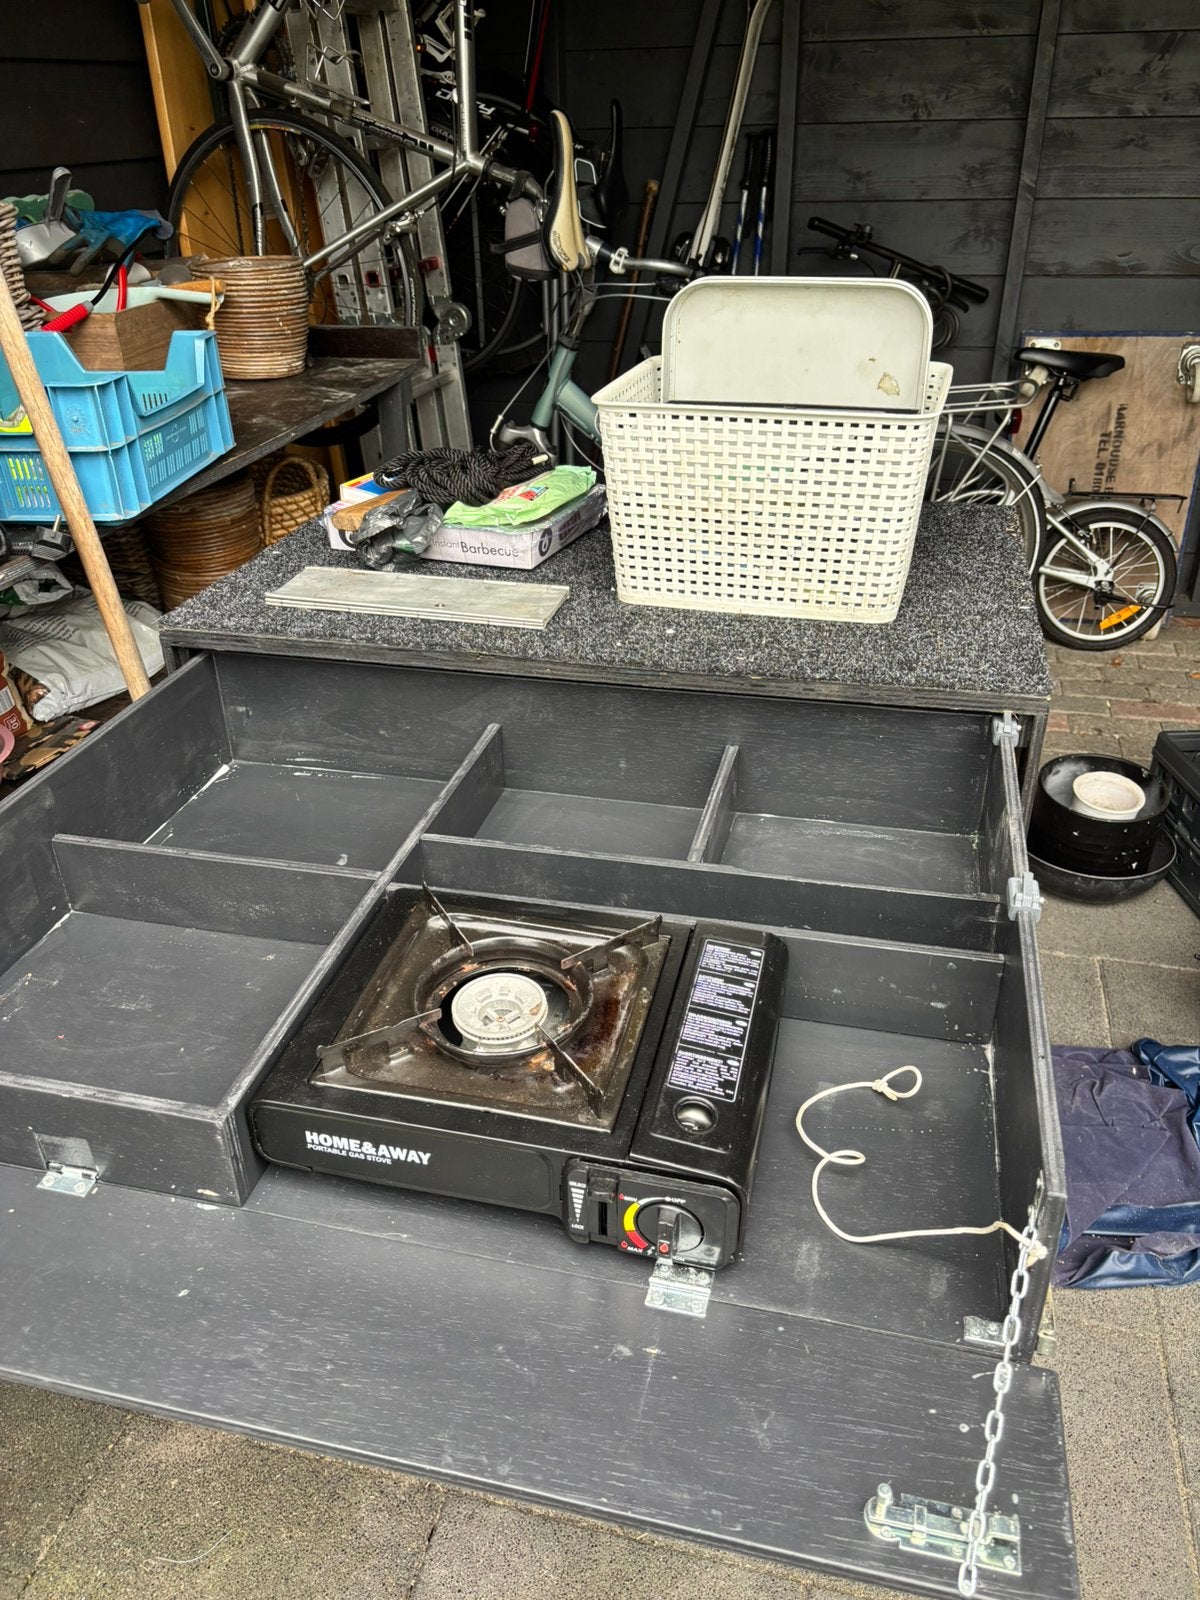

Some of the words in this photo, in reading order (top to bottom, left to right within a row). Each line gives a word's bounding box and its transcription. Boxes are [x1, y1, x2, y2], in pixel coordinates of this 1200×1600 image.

[1097, 431, 1112, 459] TEL.
[460, 541, 519, 557] Barbecue
[9, 716, 19, 730] 30
[304, 1130, 432, 1166] HOME&AWAY
[306, 1143, 347, 1156] PORTABLE
[348, 1151, 366, 1161] GAS
[366, 1154, 392, 1165] STOVE
[571, 1223, 585, 1231] LOCK
[626, 1245, 644, 1254] MAX
